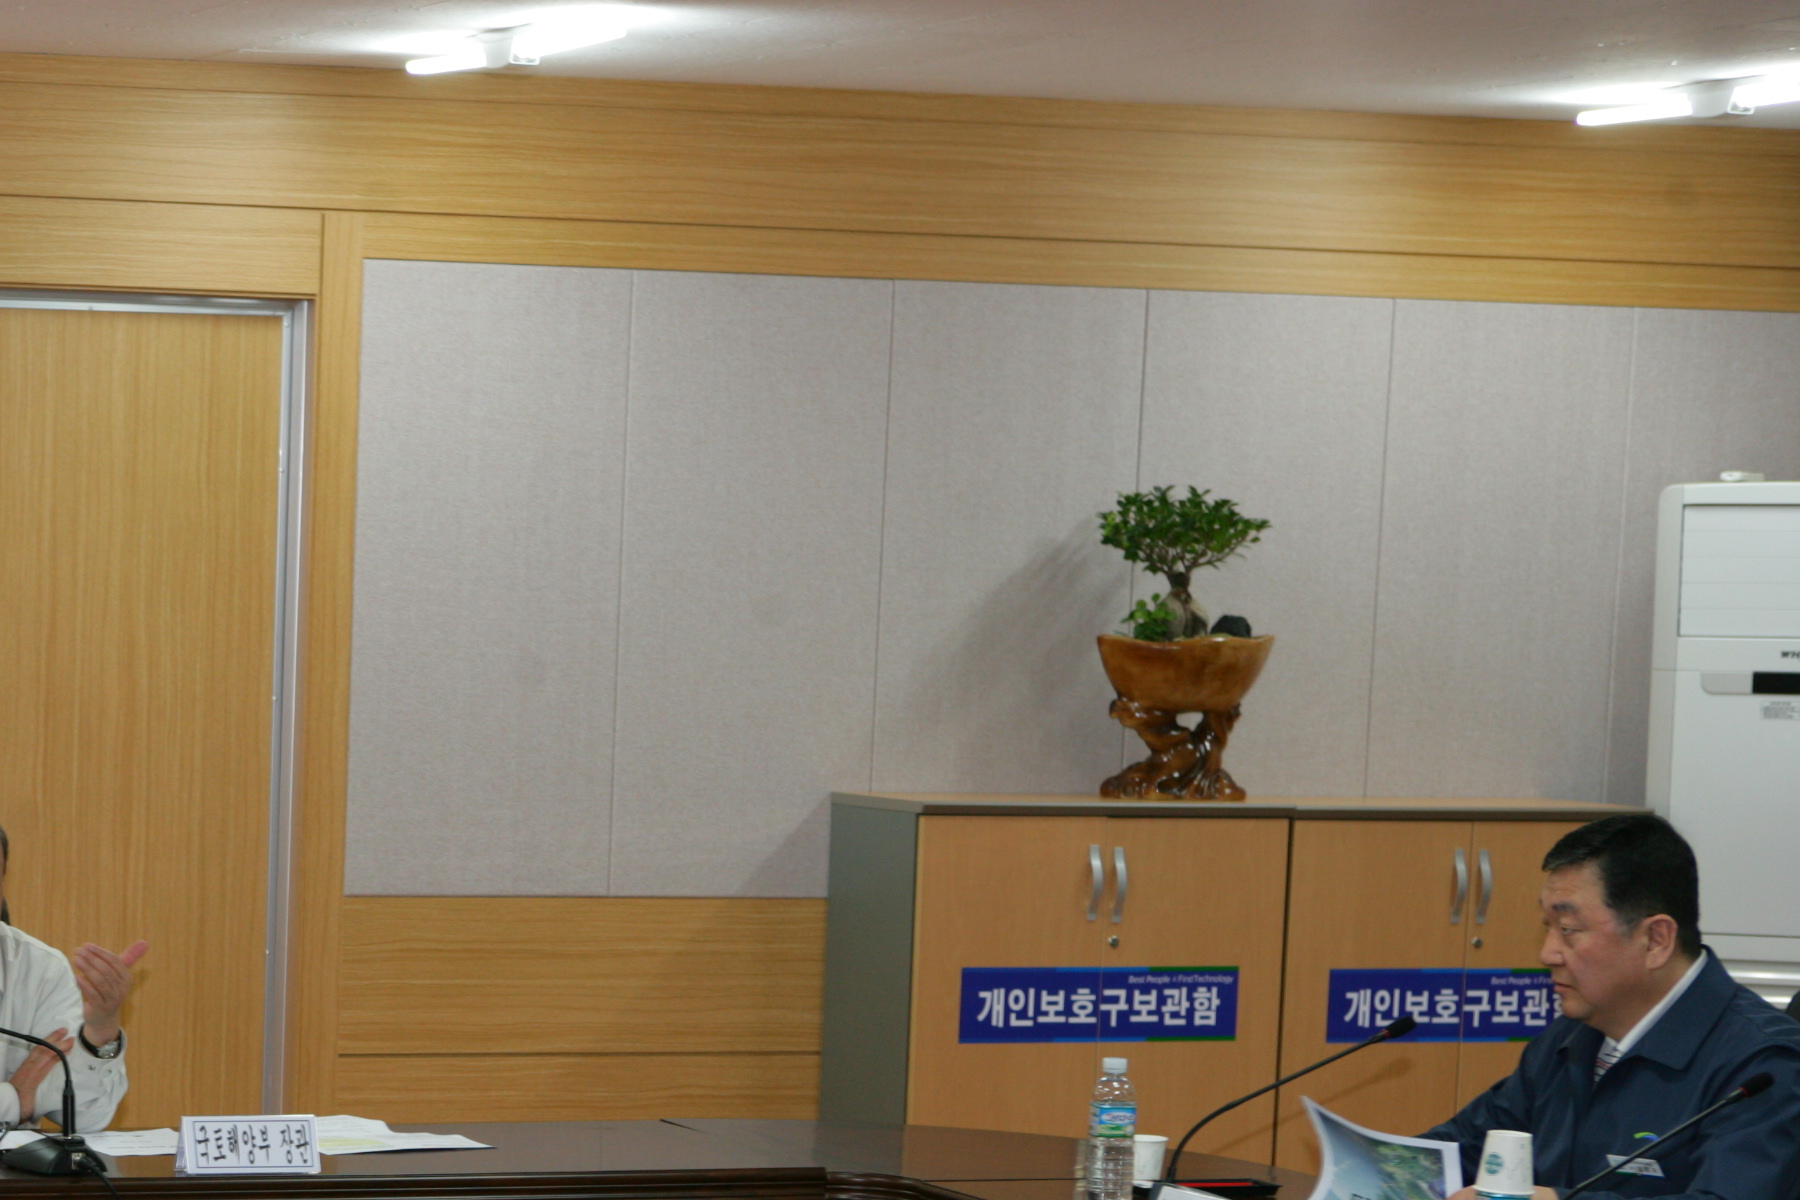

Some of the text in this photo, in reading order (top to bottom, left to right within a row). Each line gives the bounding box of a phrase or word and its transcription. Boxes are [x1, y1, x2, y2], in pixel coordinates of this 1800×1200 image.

[977, 986, 1220, 1028] 개인보호구보관함
[196, 1123, 272, 1165] 국토해양부
[279, 1123, 310, 1164] 장관
